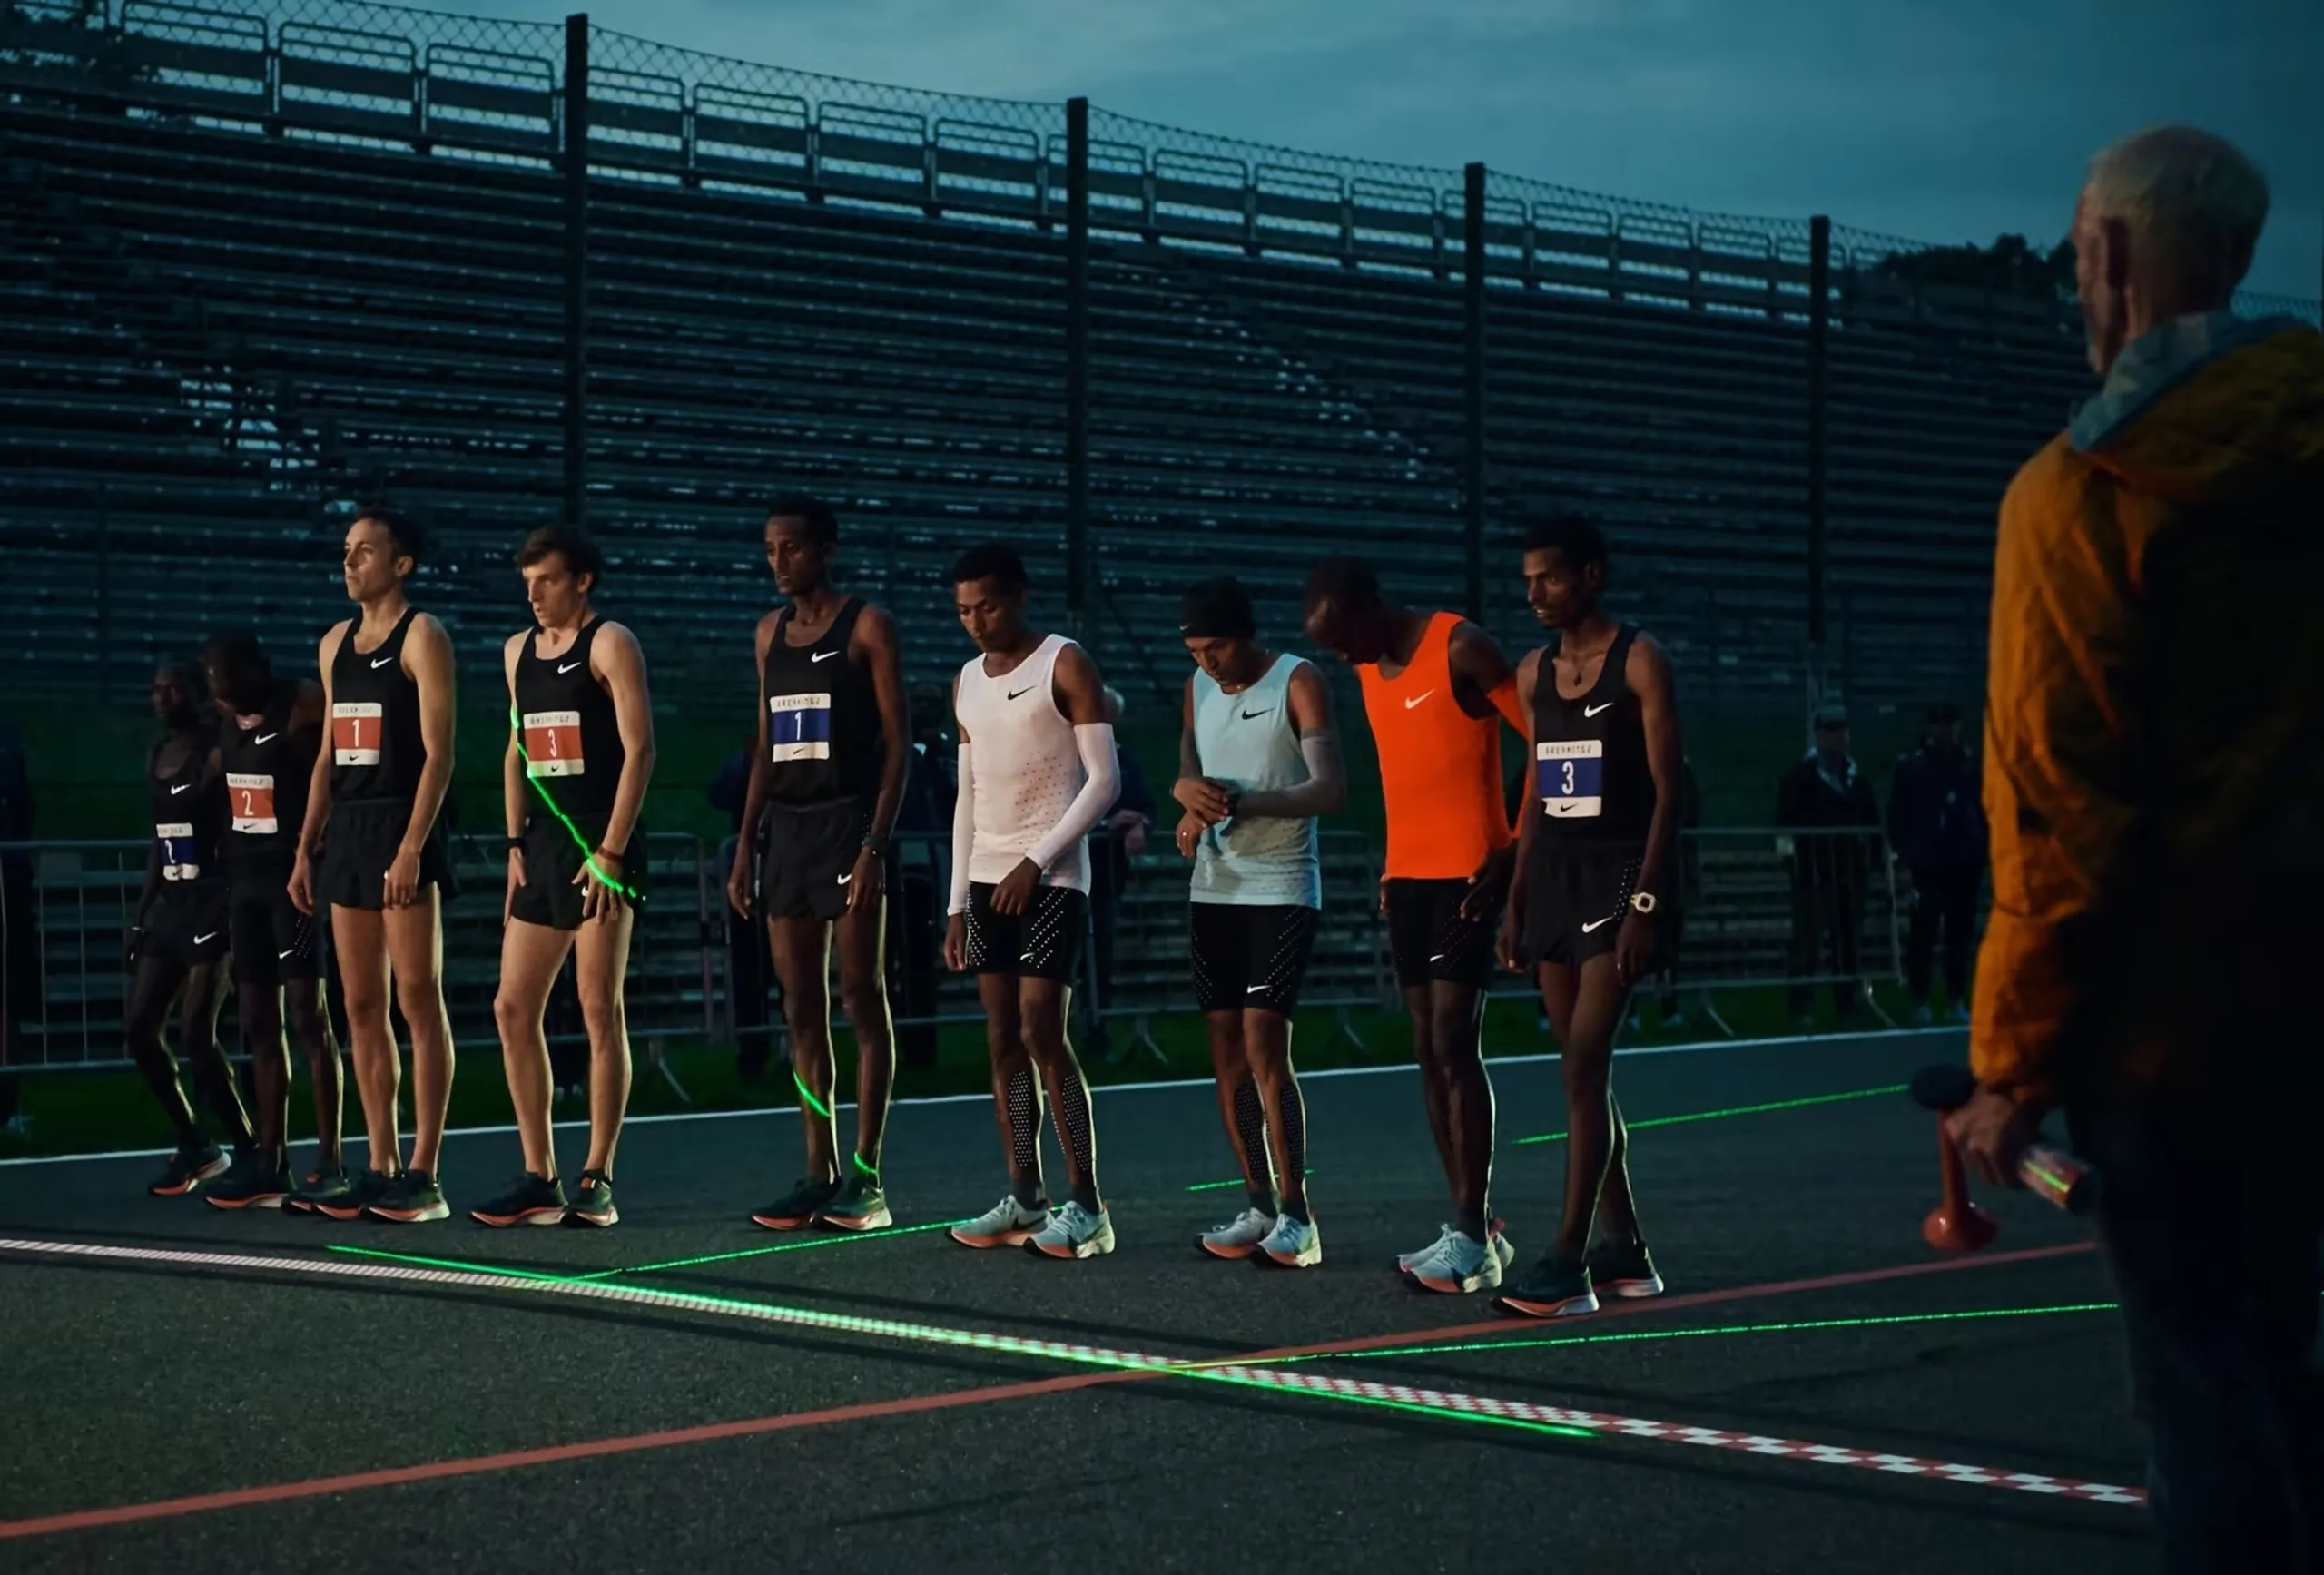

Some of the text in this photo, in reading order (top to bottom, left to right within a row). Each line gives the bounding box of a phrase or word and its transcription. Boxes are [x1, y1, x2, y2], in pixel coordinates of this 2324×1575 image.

[351, 718, 359, 747] 1
[794, 711, 802, 741] 1
[547, 728, 557, 758] 3
[1561, 761, 1574, 795] 3
[241, 790, 254, 816] 2
